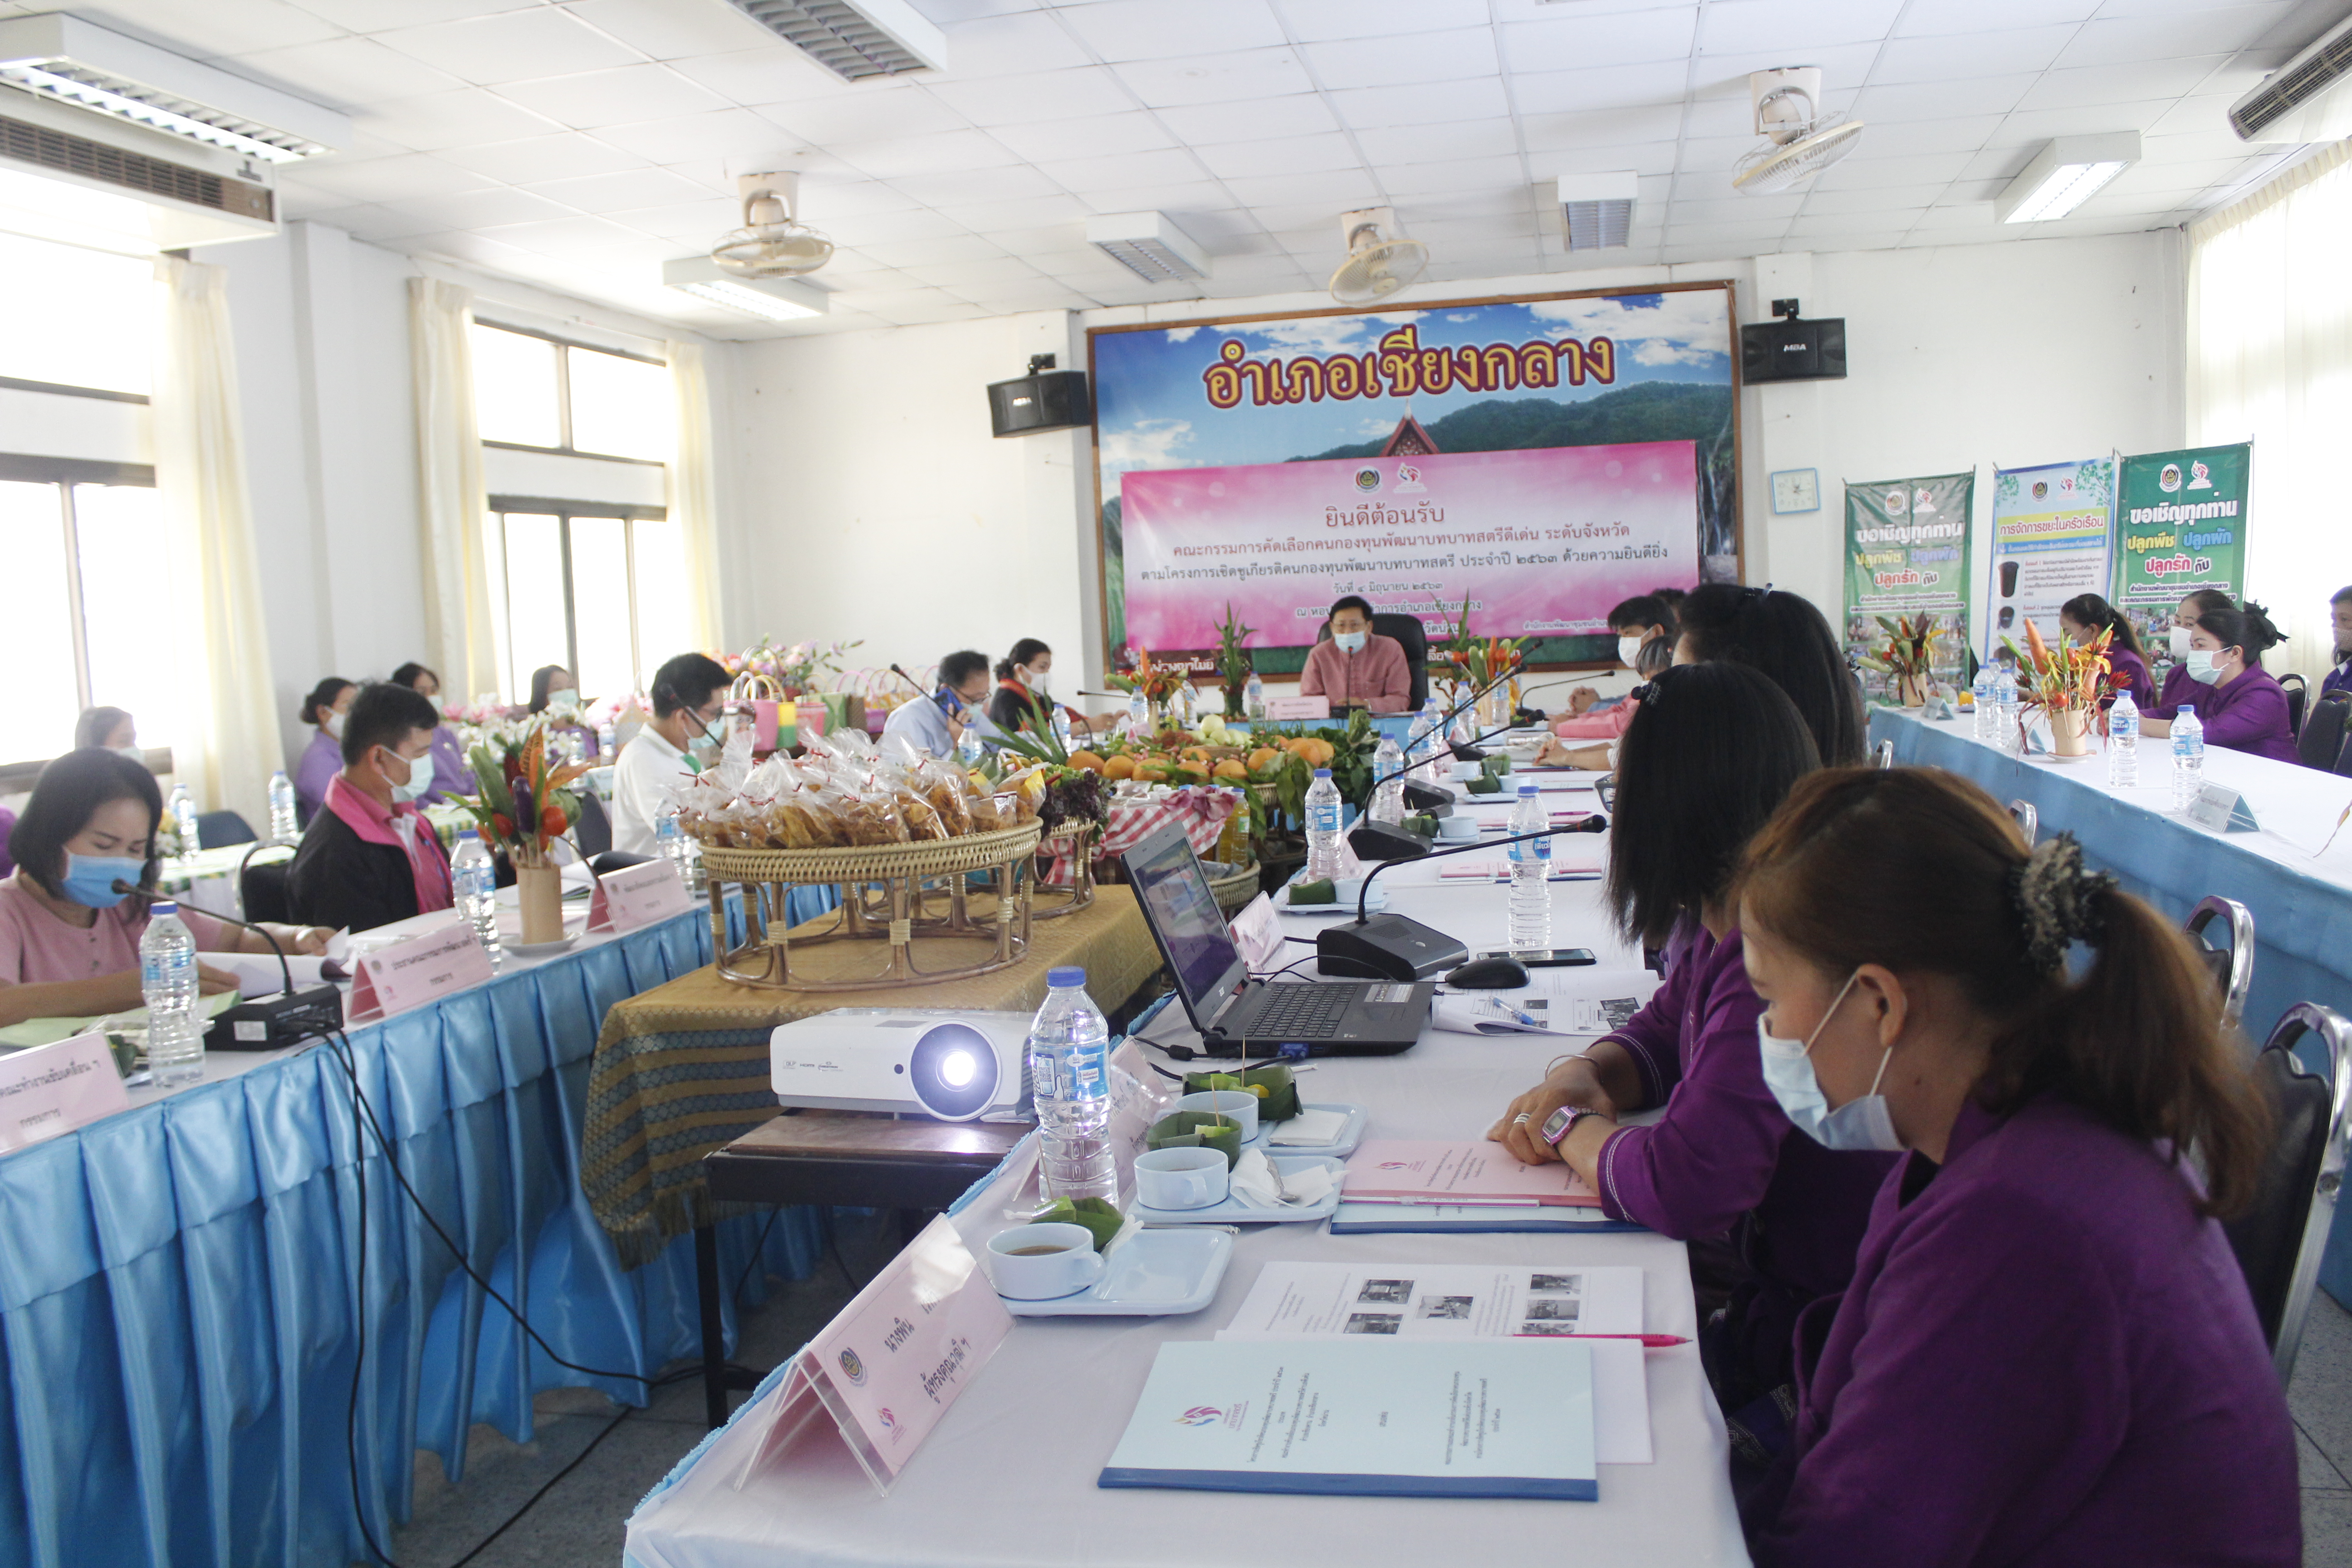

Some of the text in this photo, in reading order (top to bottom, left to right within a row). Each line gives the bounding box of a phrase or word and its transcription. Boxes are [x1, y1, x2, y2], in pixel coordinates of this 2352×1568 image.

[1203, 323, 1616, 409] อำเภอเชียงกลาง
[1325, 500, 1445, 528] ยินดีต้อนรับ
[2130, 491, 2238, 525] ขอเชิญทุกท่าน
[1545, 521, 1630, 541] ระดับจังหวัด
[1857, 515, 1964, 544] ขอเชิญทุกท่าน
[2000, 515, 2103, 535] การจัดการขยะในครัวเรือน
[1460, 551, 1511, 567] ประจำปี
[1563, 541, 1668, 563] ด้วยความยินดียิ่ง
[2127, 531, 2175, 554] ปลูกพืช
[2146, 554, 2210, 576] ปลูกรัก กับ
